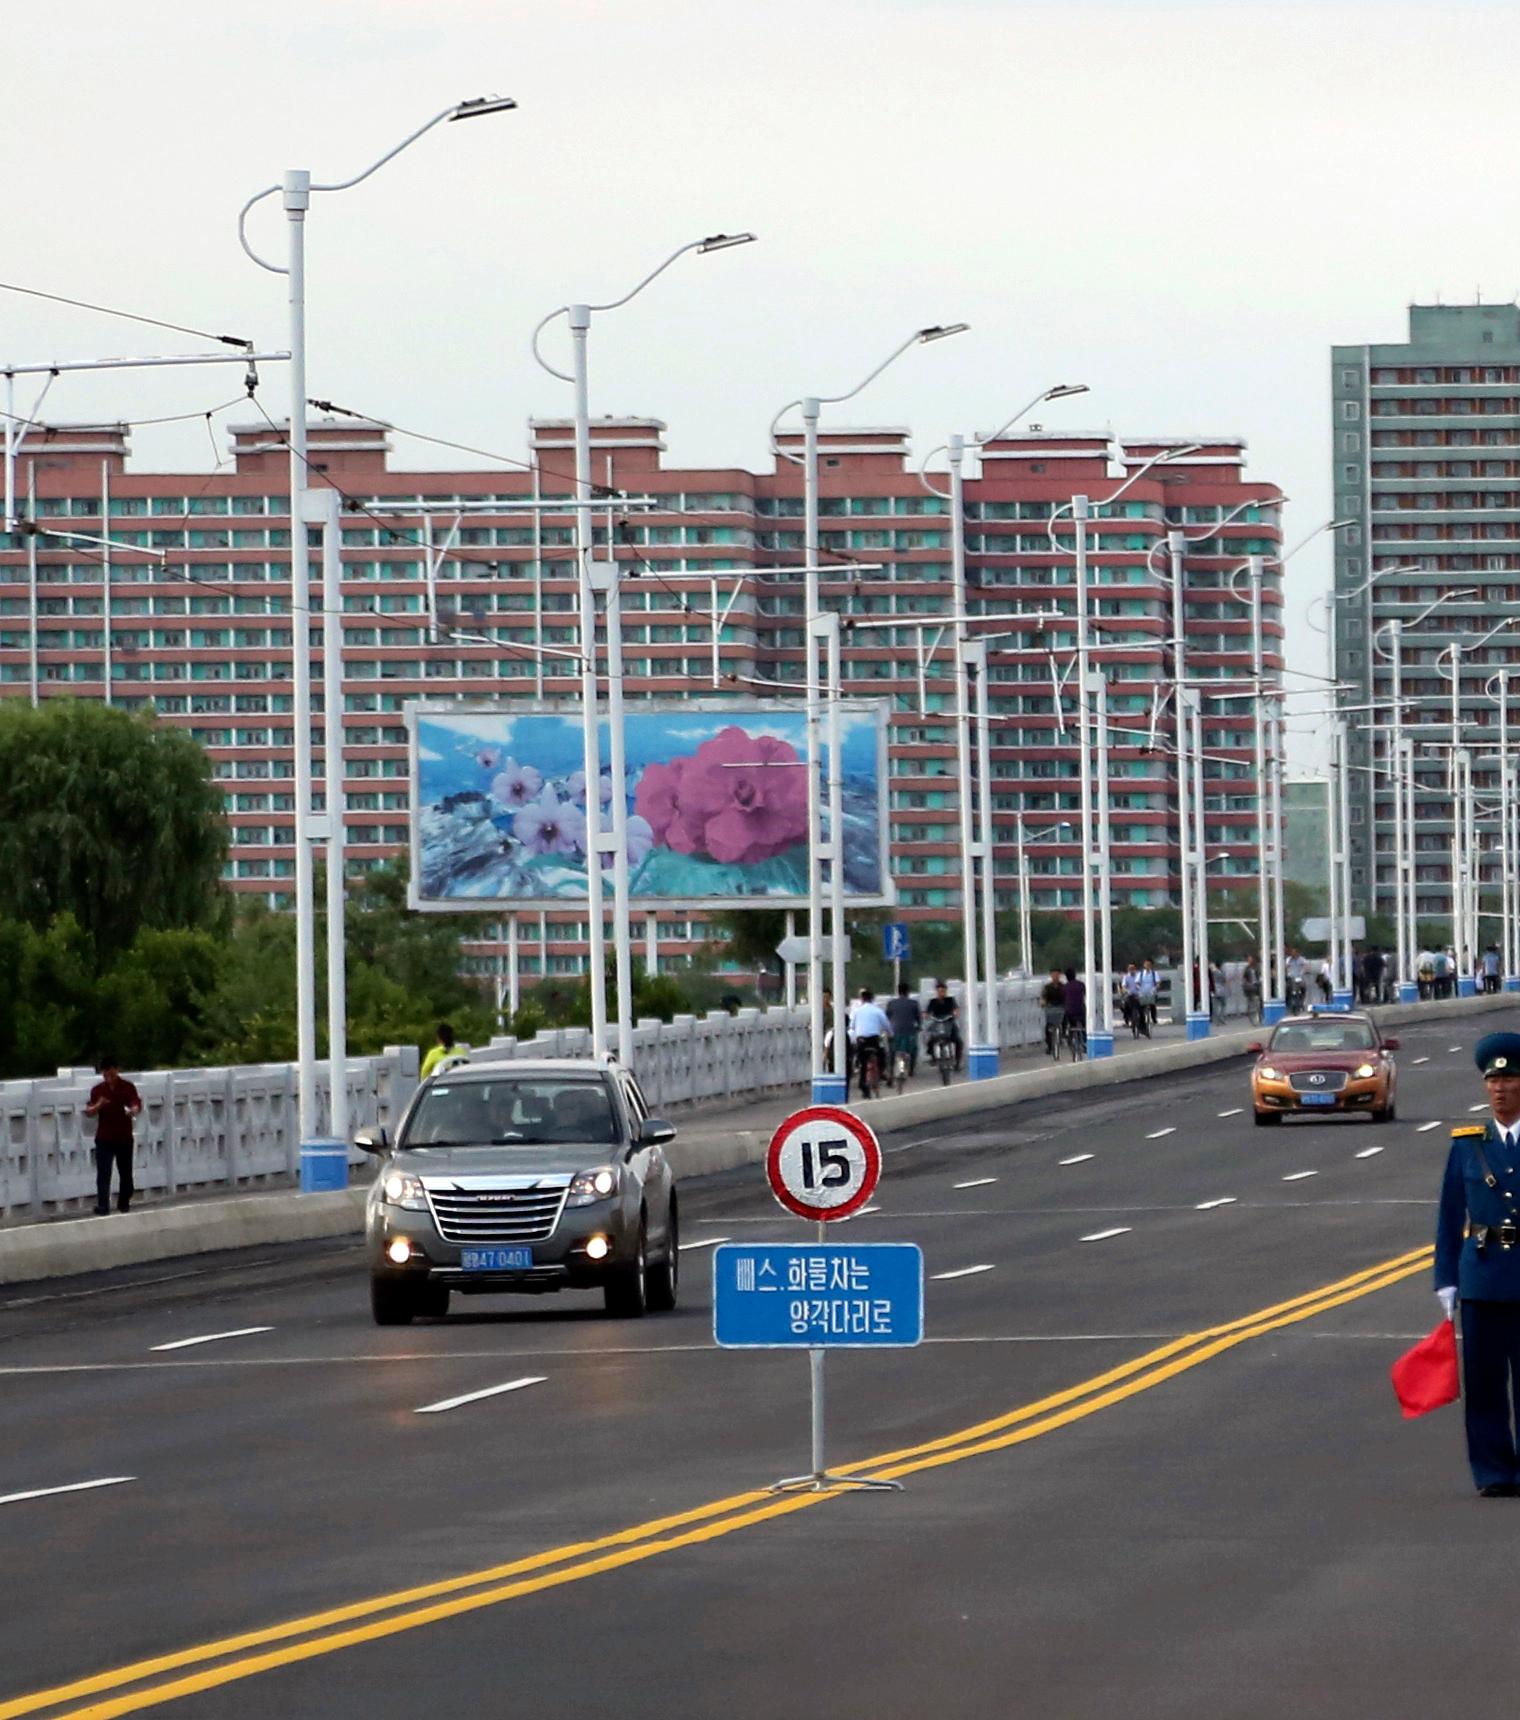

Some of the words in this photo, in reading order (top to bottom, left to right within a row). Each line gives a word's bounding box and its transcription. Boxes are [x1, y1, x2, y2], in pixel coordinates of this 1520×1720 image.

[801, 1139, 850, 1189] 15
[498, 1250, 530, 1267] 0401
[790, 1300, 893, 1334] 양각다리로
